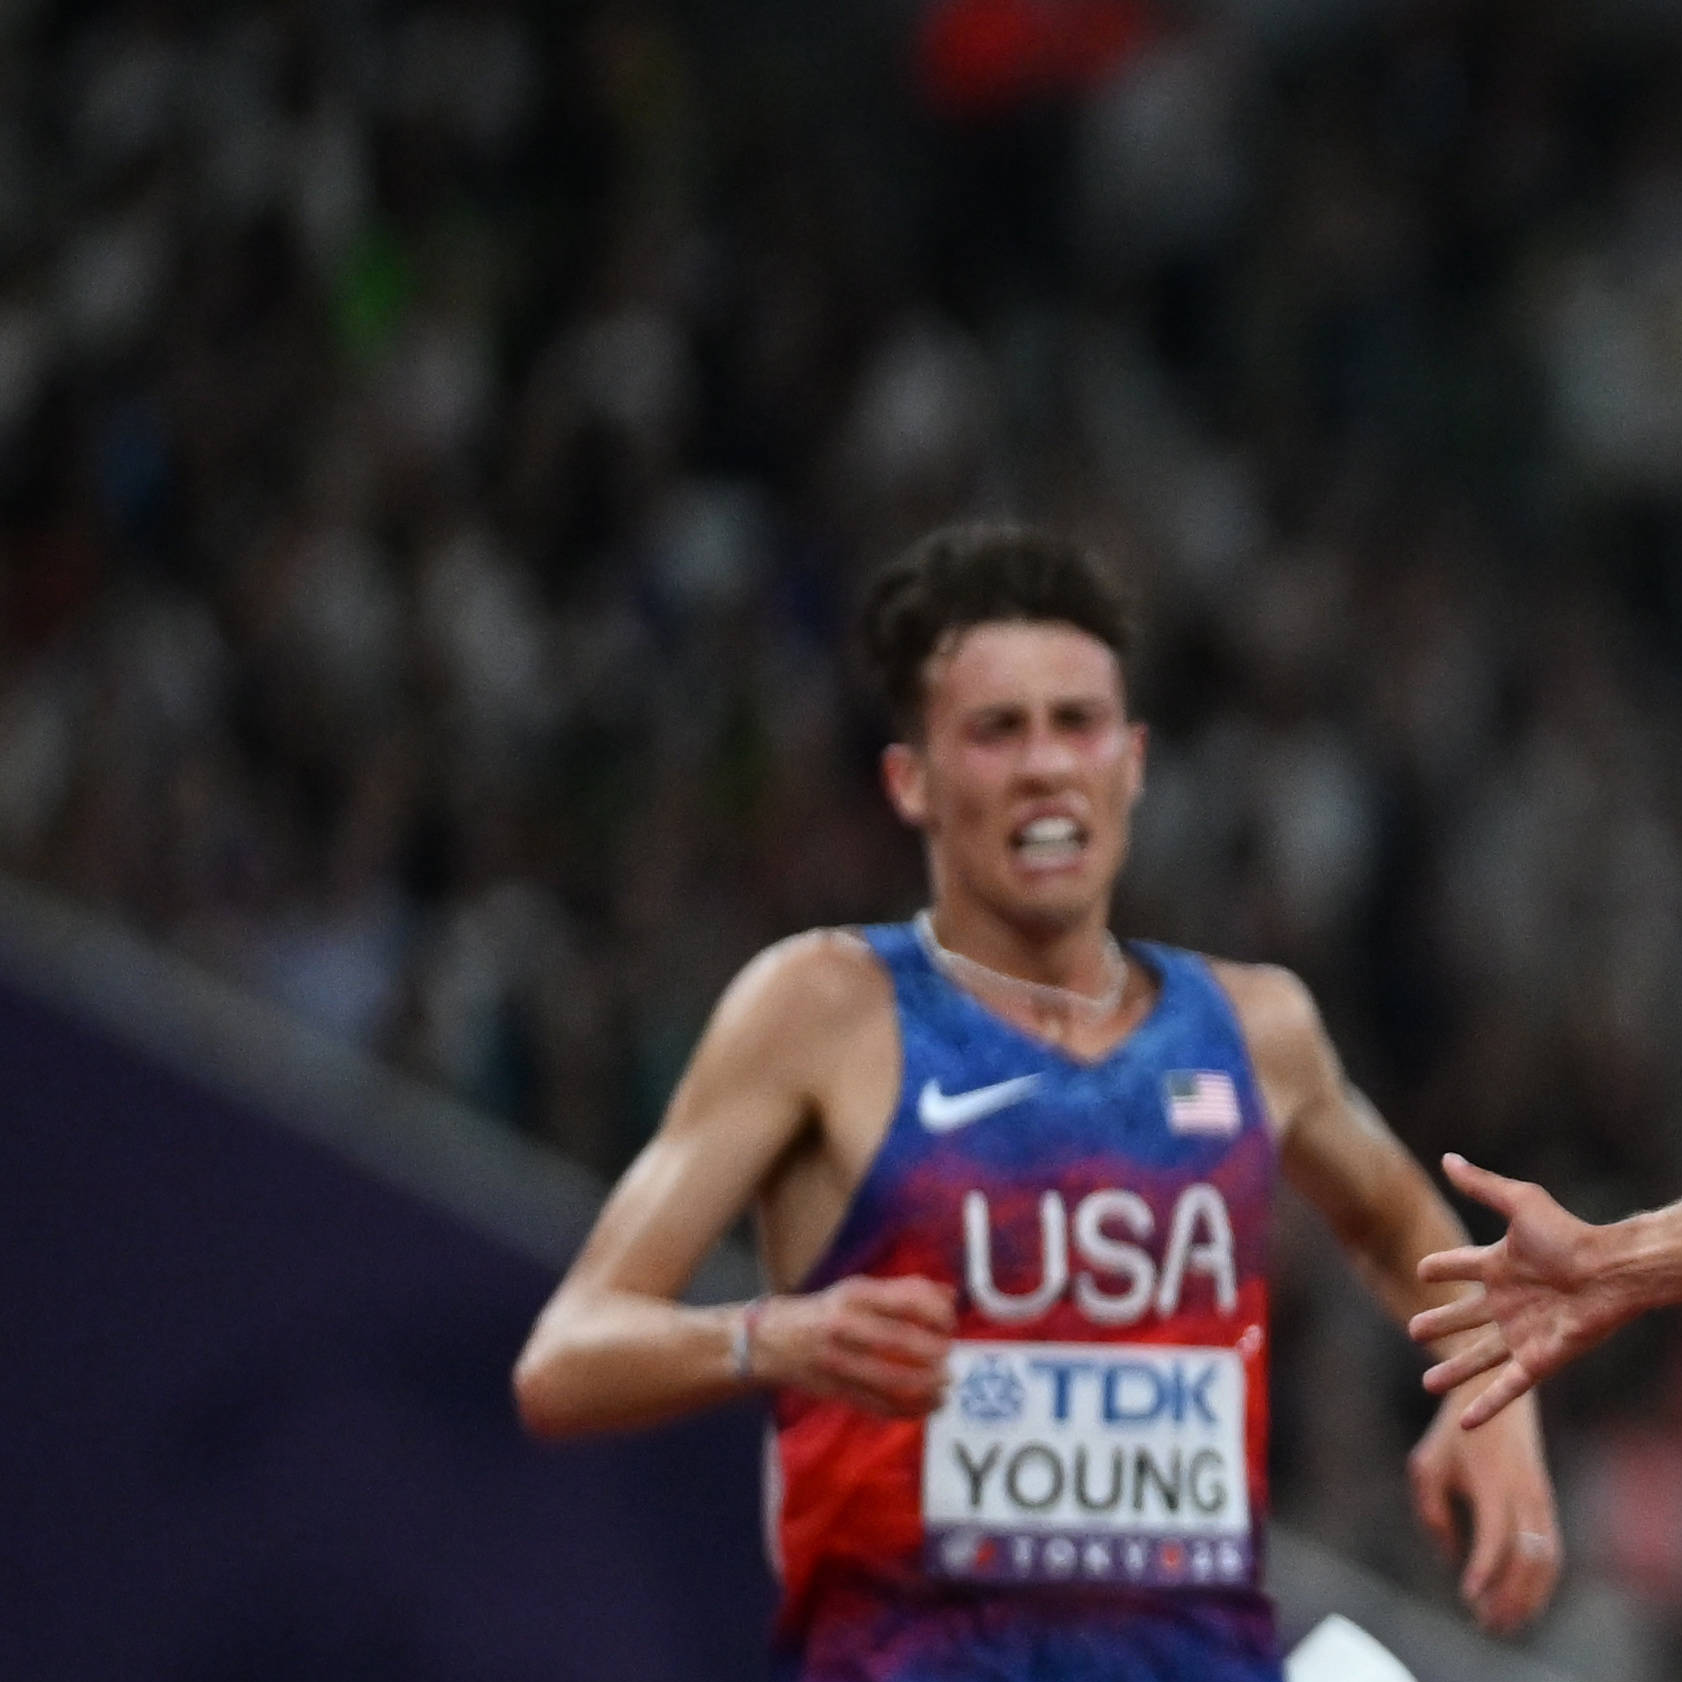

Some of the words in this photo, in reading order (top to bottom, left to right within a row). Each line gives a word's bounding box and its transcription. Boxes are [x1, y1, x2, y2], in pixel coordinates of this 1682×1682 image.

[962, 1182, 1239, 1327] USA
[1028, 1358, 1218, 1426] TDK
[953, 1438, 1229, 1513] YOUNG
